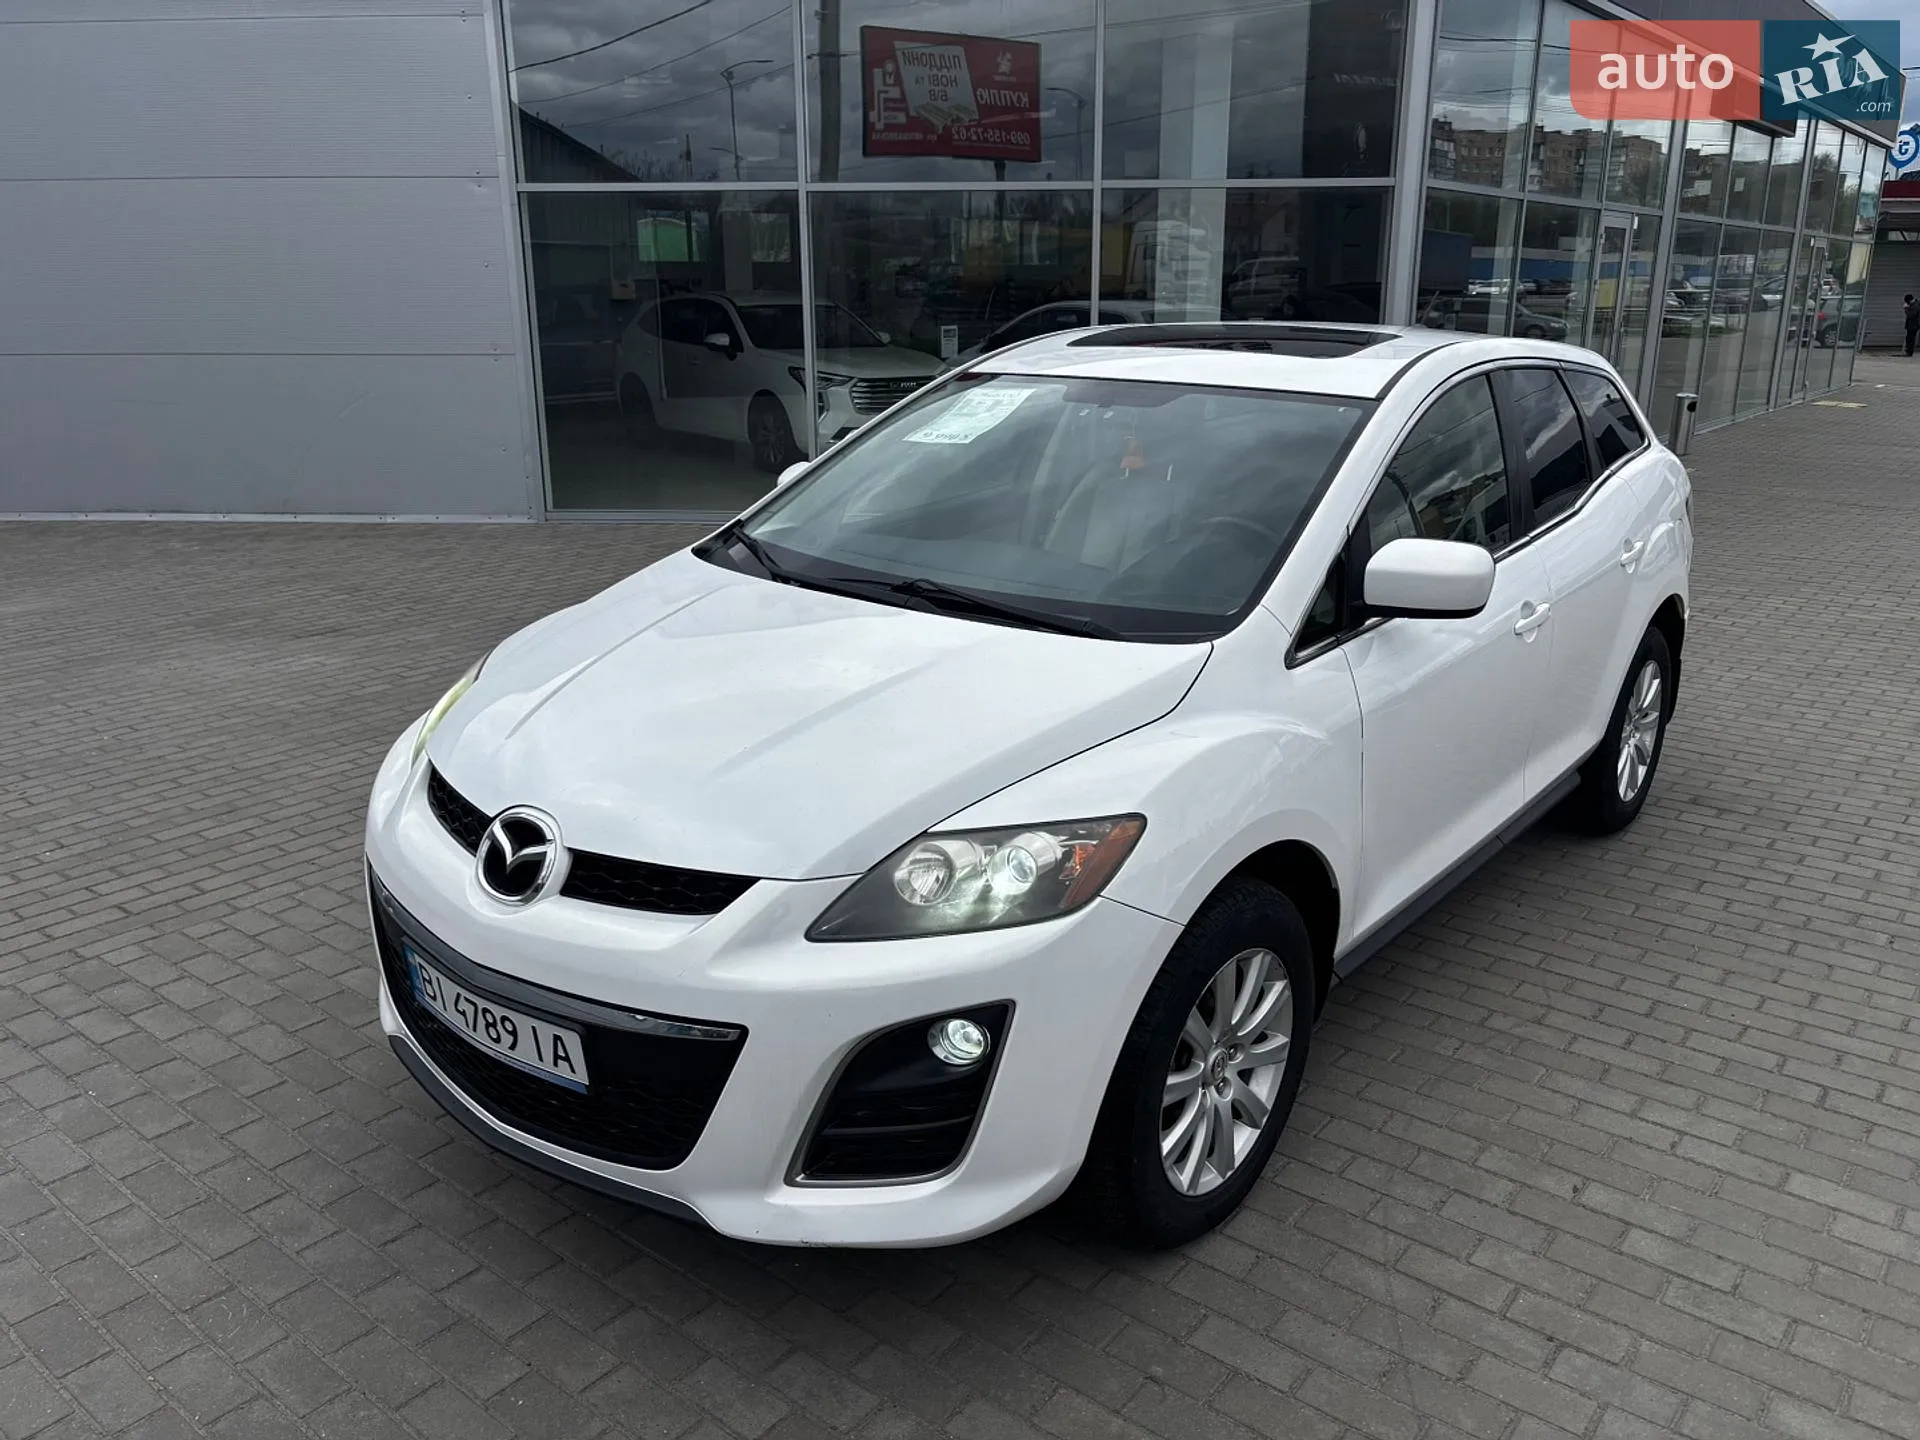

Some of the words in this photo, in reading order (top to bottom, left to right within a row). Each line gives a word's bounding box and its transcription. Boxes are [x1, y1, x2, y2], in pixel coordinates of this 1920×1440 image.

[418, 962, 448, 1012] BI
[454, 992, 518, 1051] 4789
[531, 1025, 576, 1074] IA
